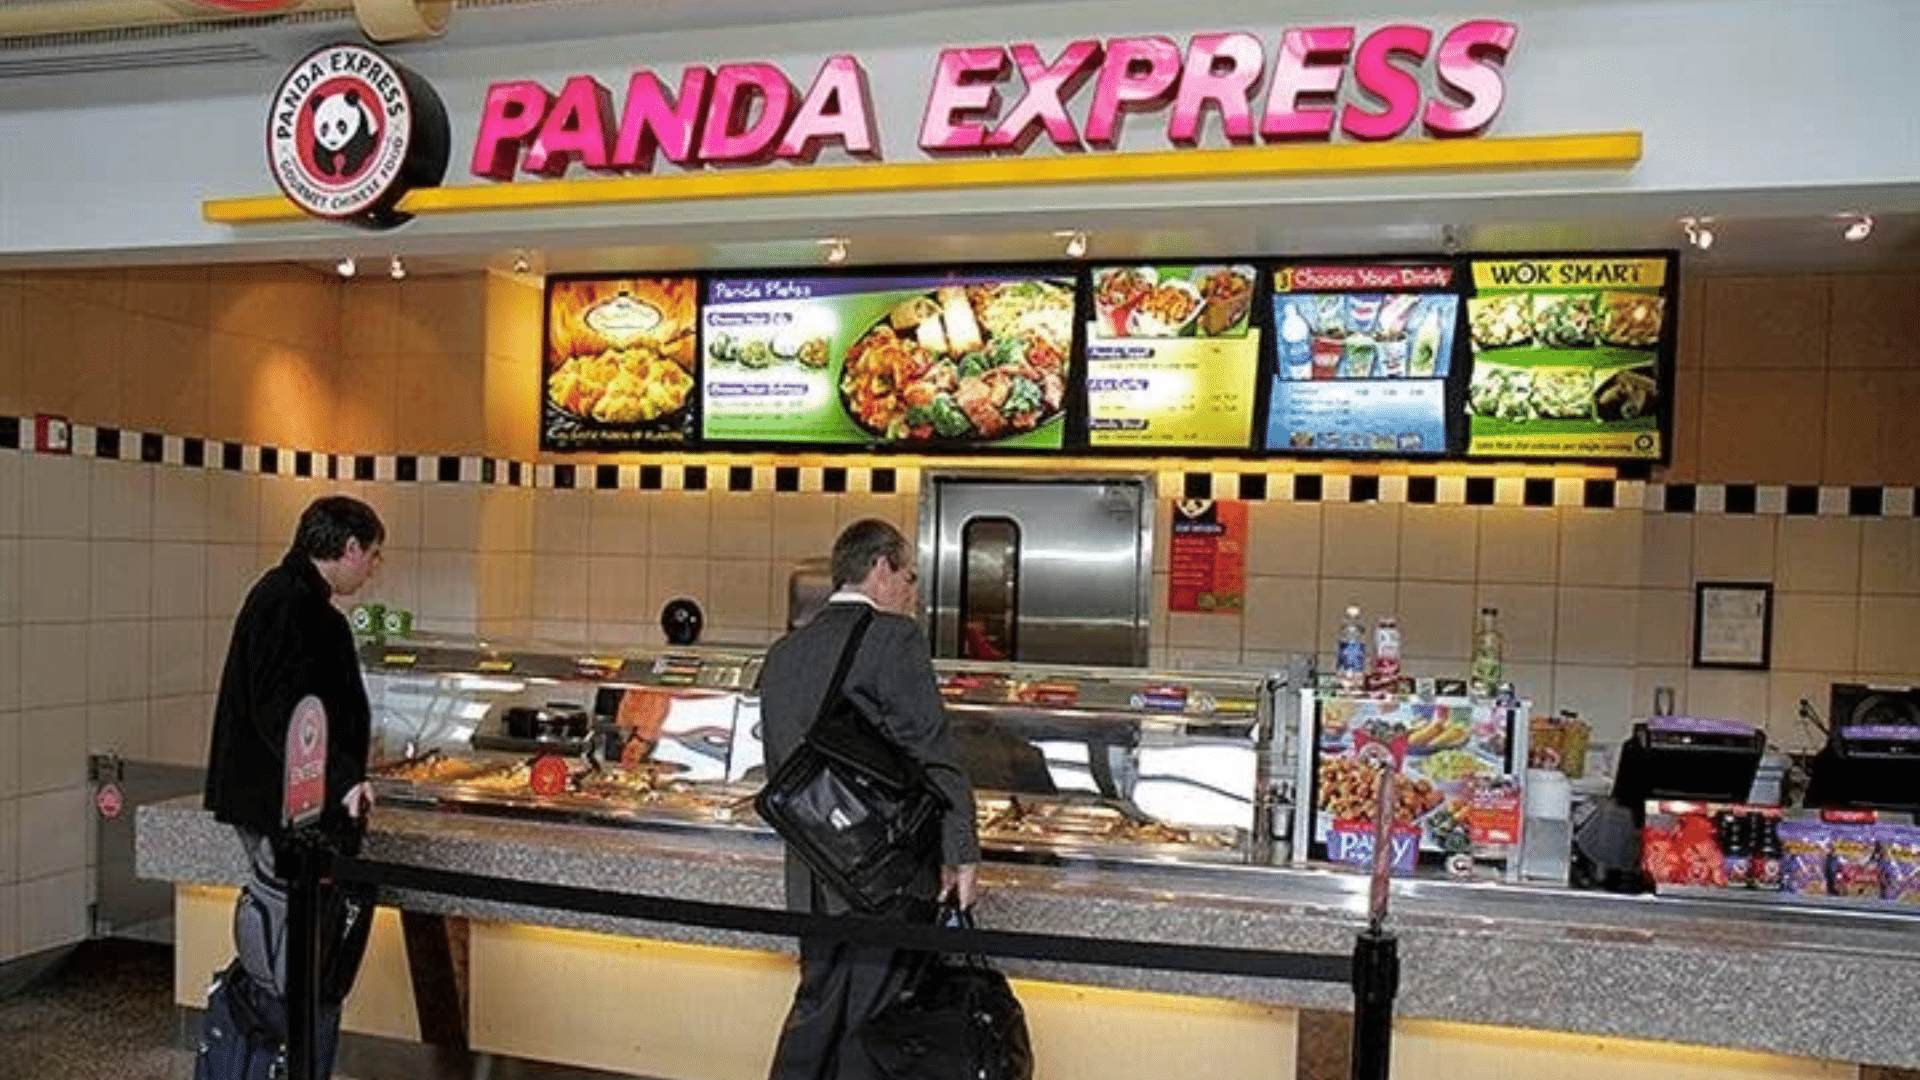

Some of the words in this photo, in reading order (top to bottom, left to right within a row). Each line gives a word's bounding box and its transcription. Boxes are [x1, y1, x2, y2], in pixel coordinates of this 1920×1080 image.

[276, 62, 325, 140] PANDA
[330, 51, 405, 118] EXPRESS
[471, 54, 880, 181] PANDA
[918, 19, 1518, 157] EXPRESS
[280, 159, 328, 209] GOURMET
[380, 137, 404, 179] FOOD
[716, 281, 761, 299] Panda
[1295, 267, 1355, 287] Choose
[1358, 268, 1400, 286] Your
[1402, 266, 1449, 287] Drink
[1491, 263, 1552, 284] WOK
[1560, 263, 1643, 284] SMART
[1340, 832, 1411, 865] PAY
